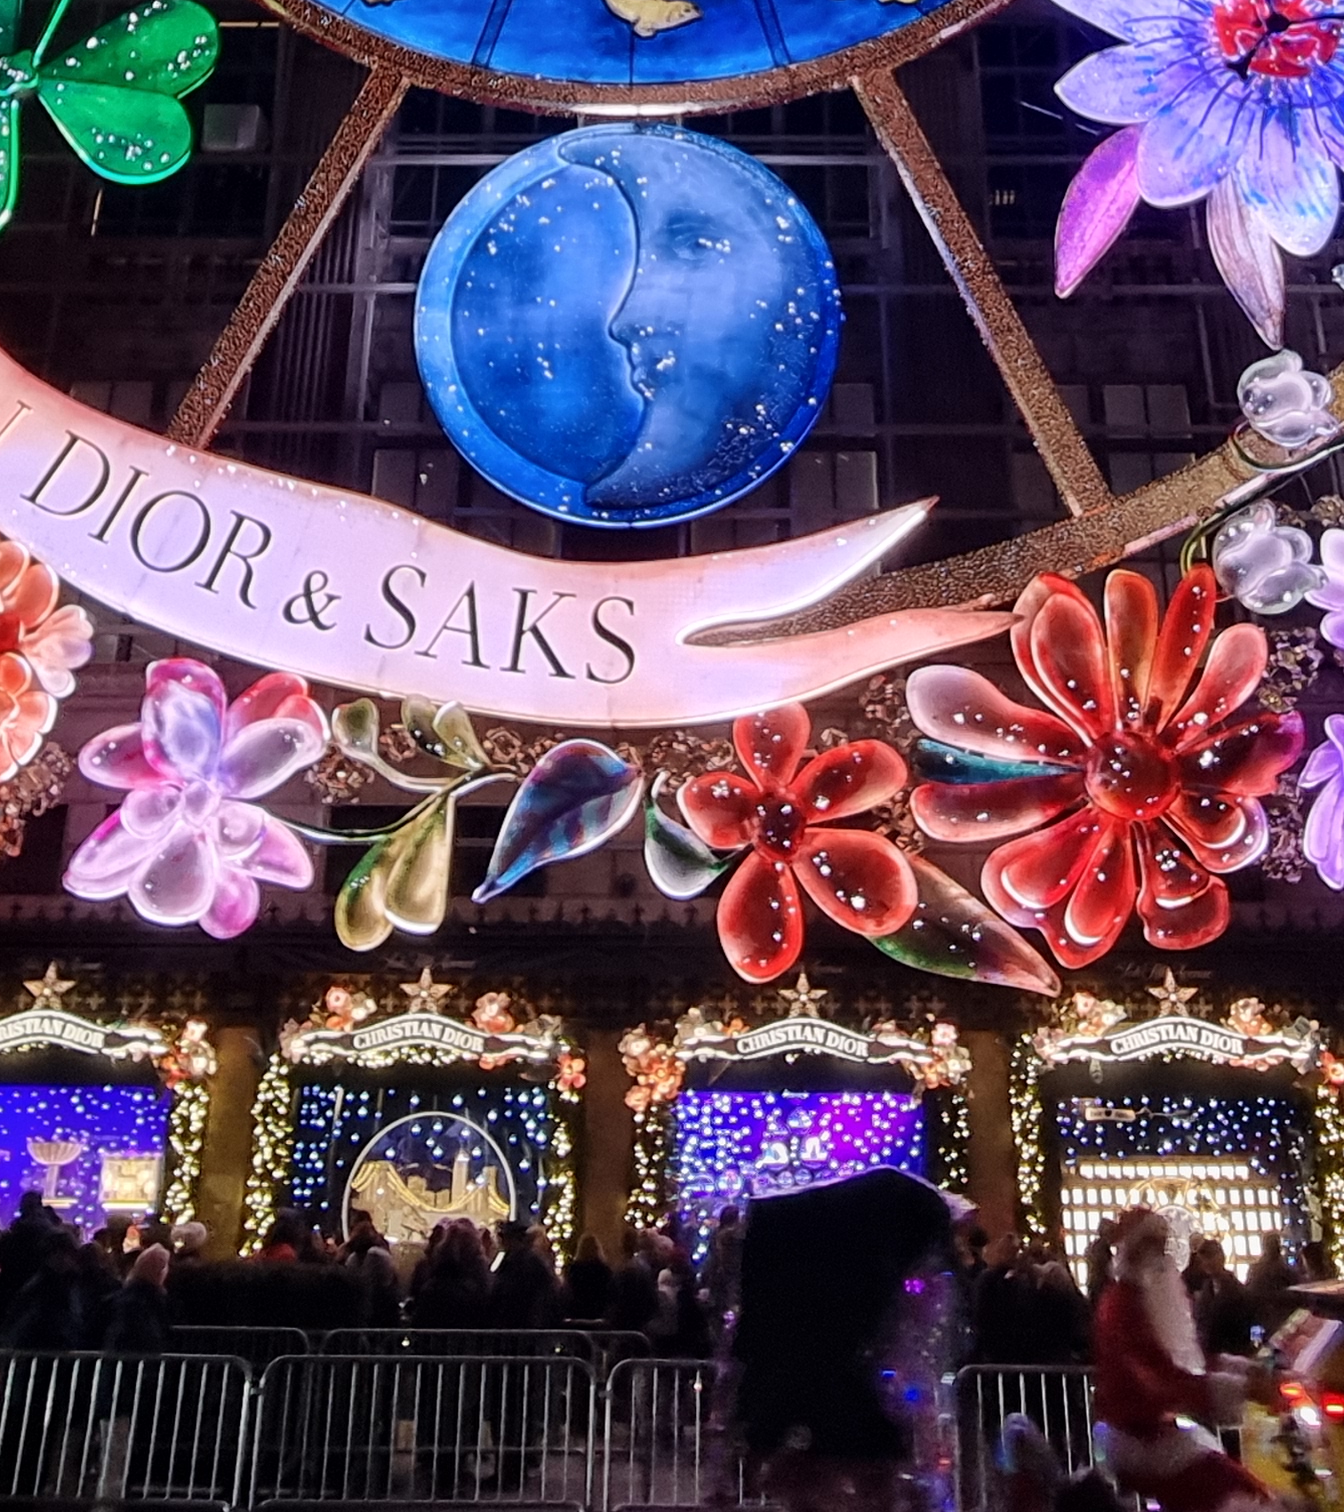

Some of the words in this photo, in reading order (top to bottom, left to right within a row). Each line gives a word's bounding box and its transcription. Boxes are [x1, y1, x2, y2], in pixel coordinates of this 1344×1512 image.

[20, 429, 273, 610] DIOR
[283, 570, 342, 631] &
[364, 564, 637, 684] SAKS
[62, 1023, 105, 1048] DIOR
[353, 1021, 443, 1049] CHRISTIAN
[441, 1026, 485, 1052] DIOR
[736, 1025, 826, 1054] CHRISTIAN
[826, 1031, 869, 1057] DIOR
[1110, 1024, 1199, 1054] CHRISTIAN
[1200, 1029, 1244, 1055] DIOR
